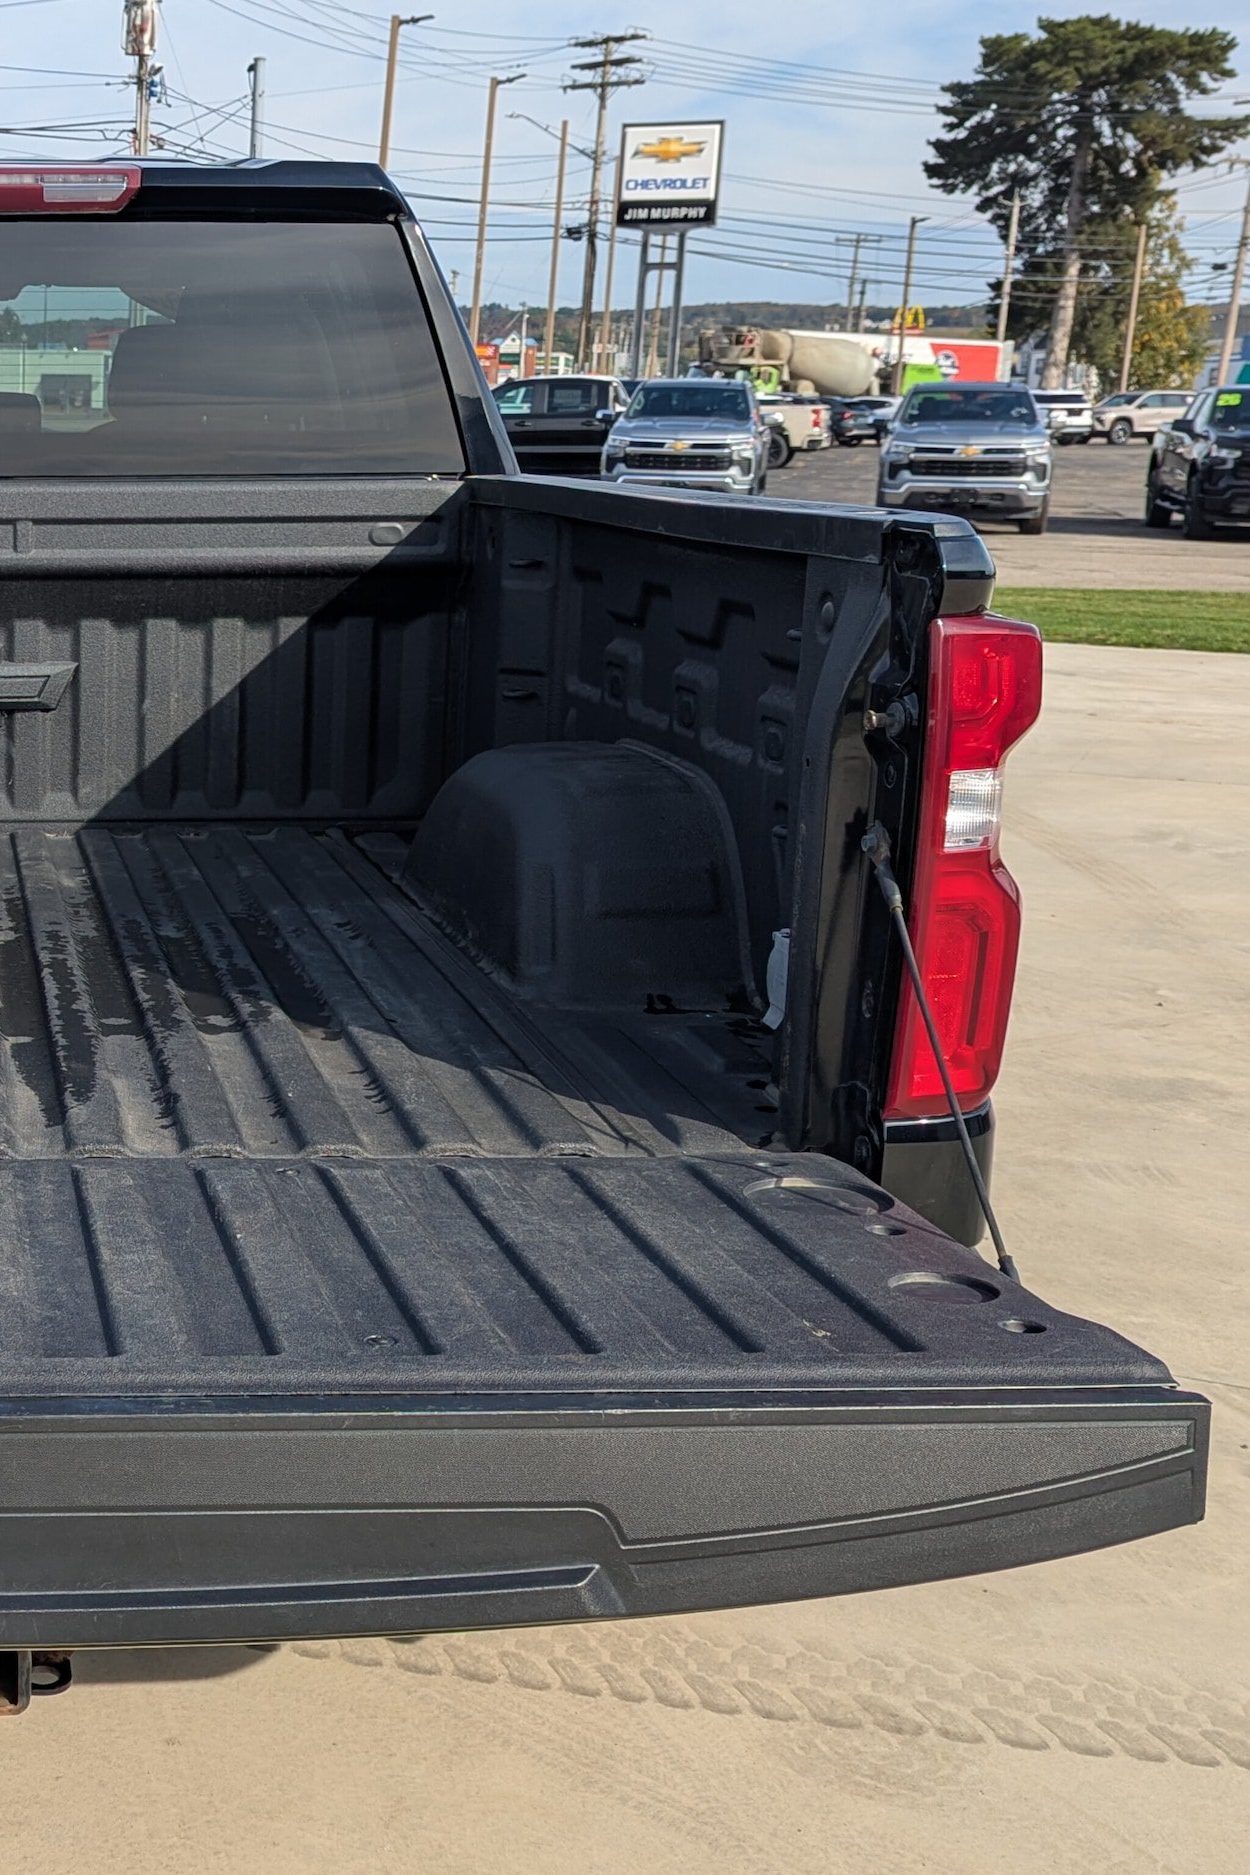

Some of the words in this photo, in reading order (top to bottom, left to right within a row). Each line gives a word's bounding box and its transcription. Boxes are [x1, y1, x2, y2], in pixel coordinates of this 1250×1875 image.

[625, 177, 710, 191] CHEVROLET
[624, 208, 649, 221] JIM
[651, 206, 707, 220] MURPHY
